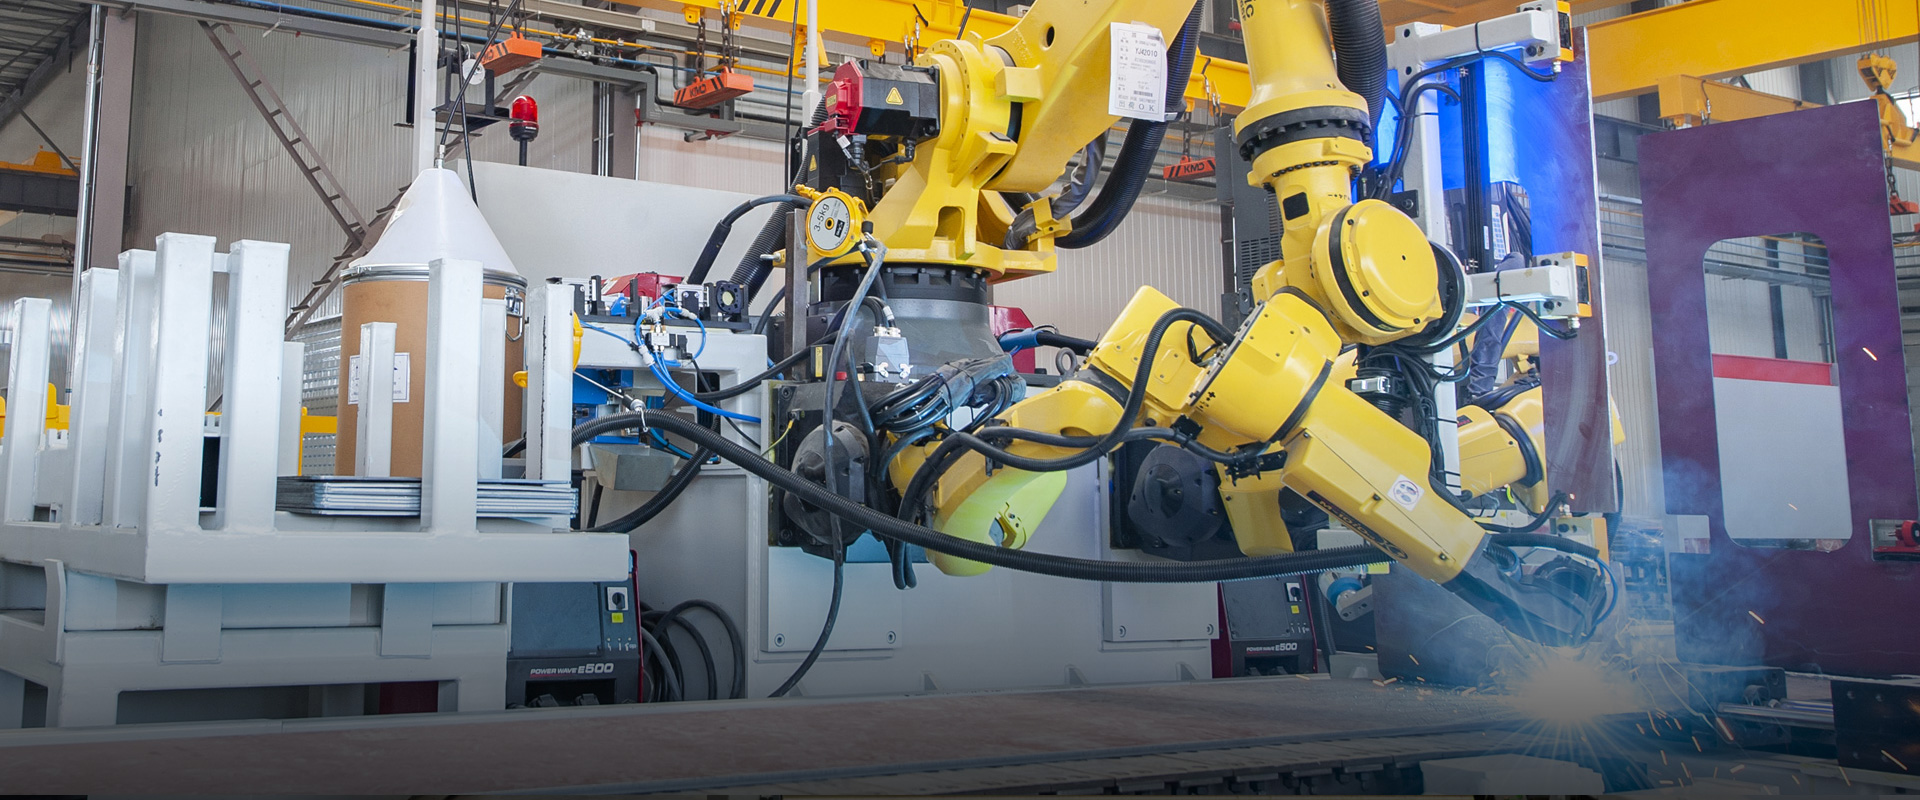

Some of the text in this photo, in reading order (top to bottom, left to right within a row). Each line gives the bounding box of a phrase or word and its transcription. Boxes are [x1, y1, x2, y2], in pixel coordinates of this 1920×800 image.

[813, 203, 830, 232] 3-5kg
[1275, 642, 1297, 651] E500
[577, 662, 614, 673] E500
